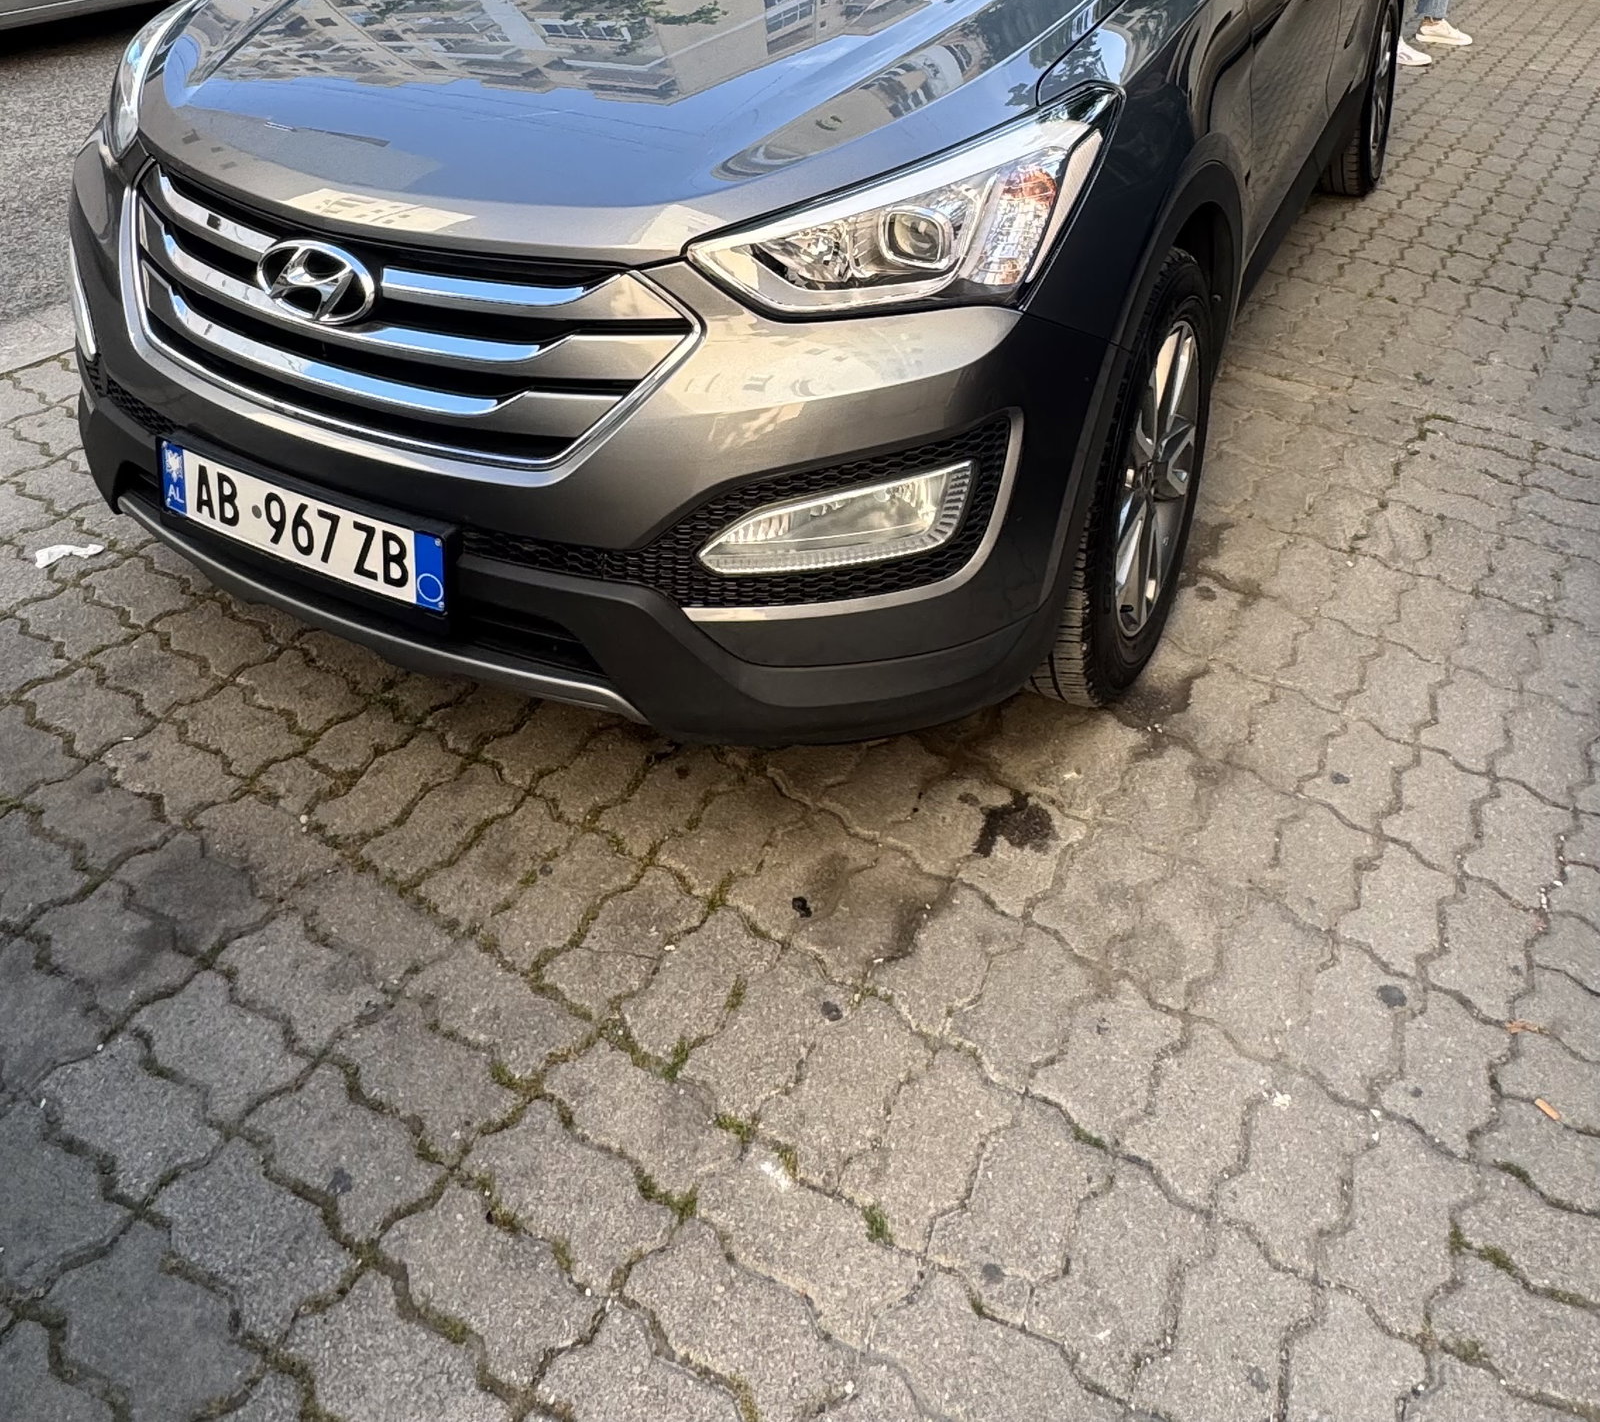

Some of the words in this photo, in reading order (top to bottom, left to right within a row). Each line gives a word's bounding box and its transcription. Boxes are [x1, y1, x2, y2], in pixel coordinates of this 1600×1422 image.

[168, 485, 184, 504] AL
[196, 464, 240, 527] AB
[264, 492, 341, 564] 967
[352, 520, 409, 588] ZB
